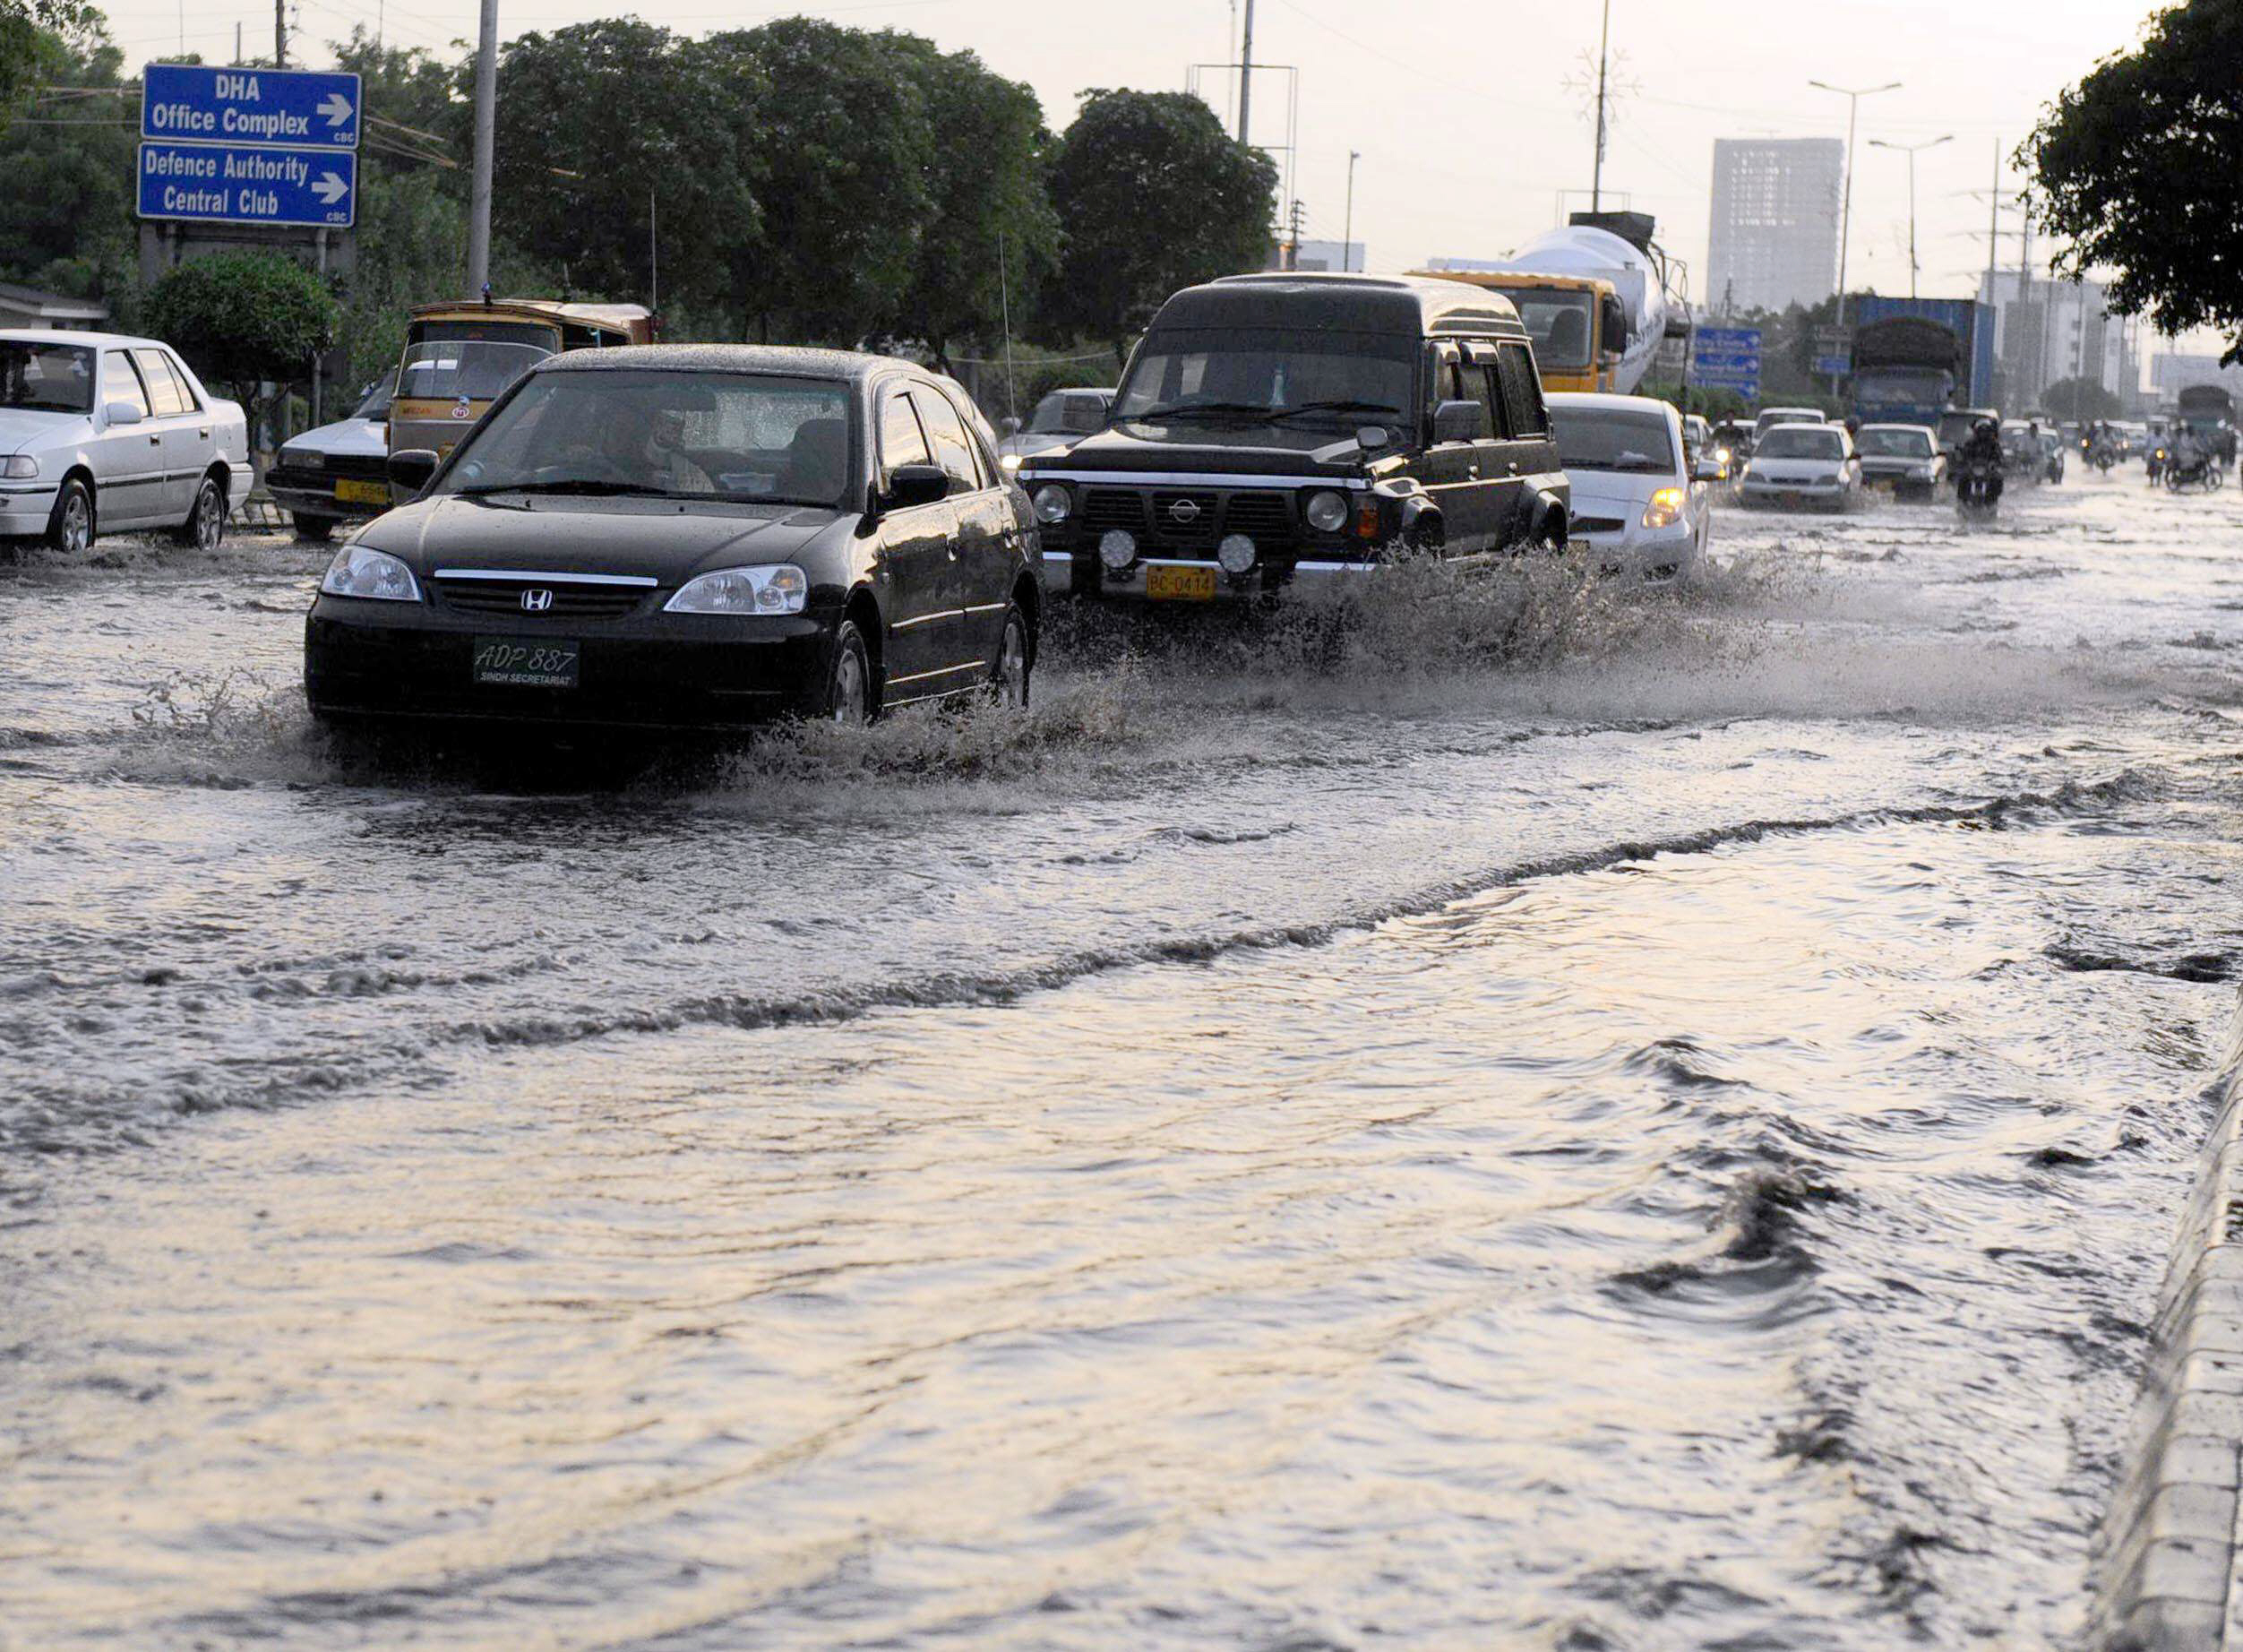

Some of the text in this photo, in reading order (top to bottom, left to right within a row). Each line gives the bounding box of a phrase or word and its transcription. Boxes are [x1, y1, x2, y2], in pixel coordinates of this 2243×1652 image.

[216, 75, 260, 100] DHA
[153, 104, 310, 138] Office Complex
[146, 151, 308, 186] Defence Authority
[164, 185, 279, 216] Central Club
[529, 649, 576, 672] 887
[480, 672, 571, 685] SINDH SECRETARIAT
